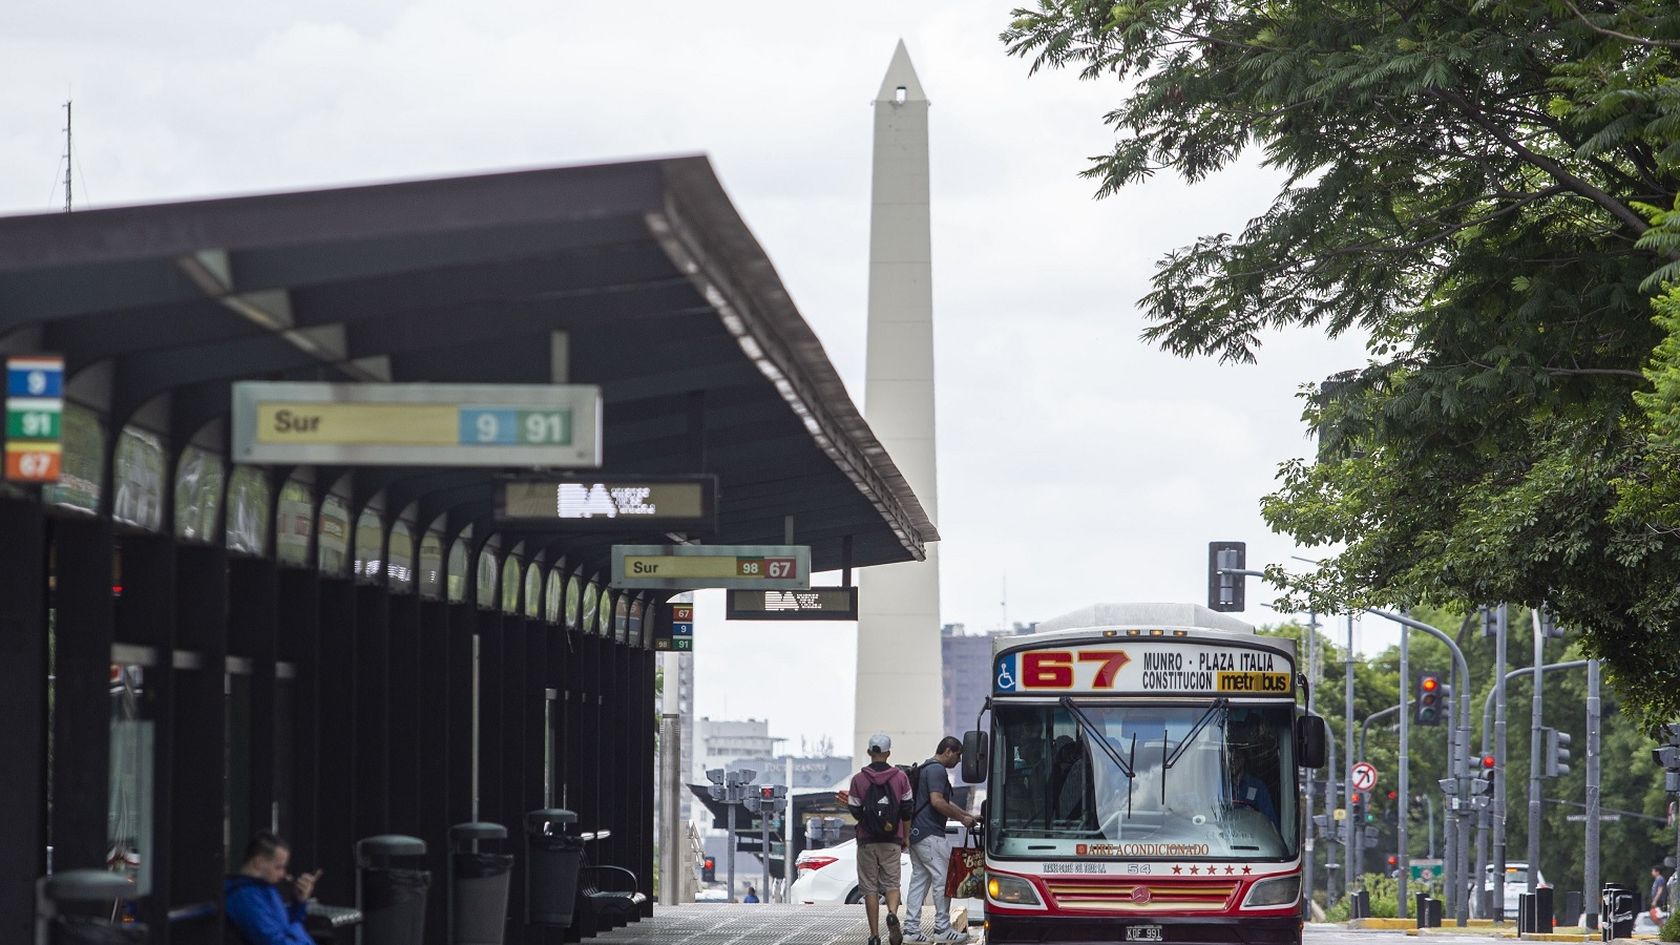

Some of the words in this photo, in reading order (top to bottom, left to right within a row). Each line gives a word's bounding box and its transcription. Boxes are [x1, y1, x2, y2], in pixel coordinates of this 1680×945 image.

[27, 371, 46, 395] 9
[22, 413, 52, 436] 91
[274, 410, 321, 435] Sur
[476, 414, 497, 442] 9
[526, 414, 564, 442] 91
[19, 454, 51, 478] 67
[633, 561, 659, 574] Sur
[742, 563, 758, 574] 98
[769, 562, 790, 577] 67
[678, 609, 689, 618] 67
[680, 625, 687, 633] 9
[678, 640, 688, 648] 91
[1020, 650, 1131, 690] 67
[1143, 652, 1182, 671] MUNRO
[1199, 652, 1234, 671] PLAZA
[1240, 653, 1274, 671] ITALIA
[1142, 672, 1212, 690] CONSTITUCION
[1089, 844, 1113, 856] AIRE
[1116, 843, 1209, 856] ACONDICIONADO
[1127, 864, 1151, 874] 54
[1146, 928, 1161, 939] 991
